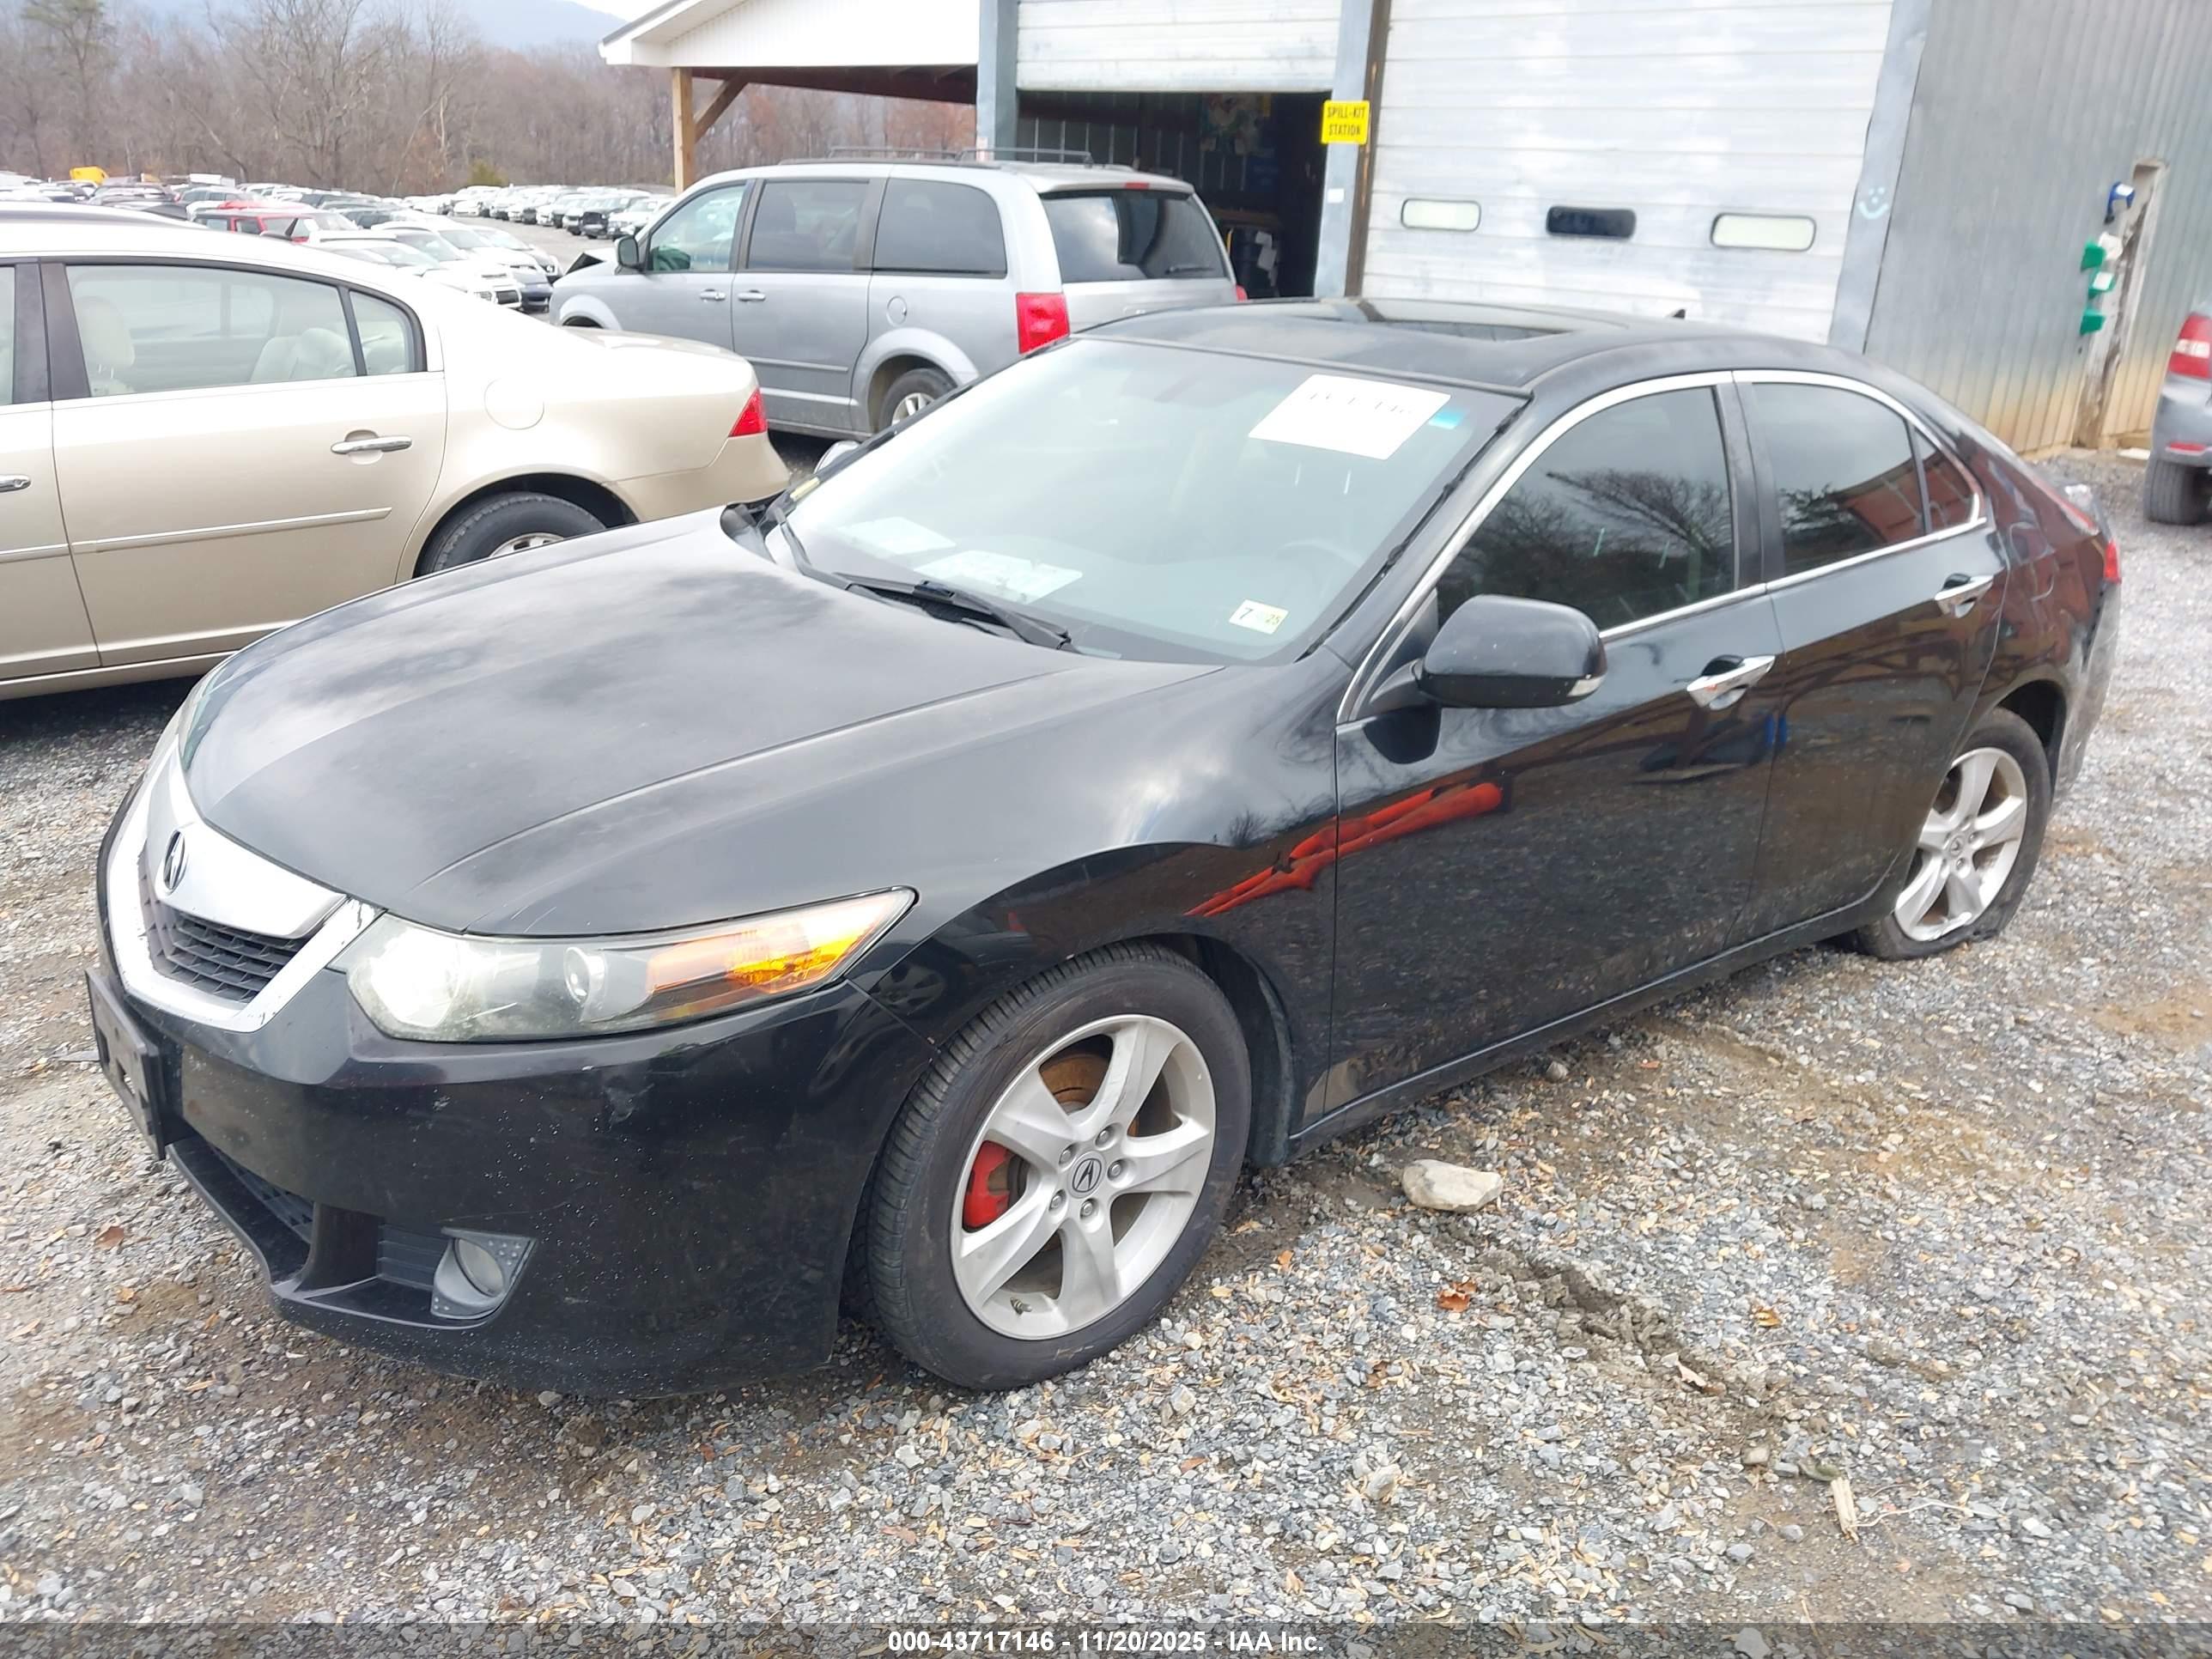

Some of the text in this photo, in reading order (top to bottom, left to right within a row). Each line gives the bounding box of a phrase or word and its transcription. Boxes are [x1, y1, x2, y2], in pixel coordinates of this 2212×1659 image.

[1328, 106, 1366, 118] SPILL-KIT
[1328, 124, 1361, 136] STATION
[1239, 606, 1254, 620] 7
